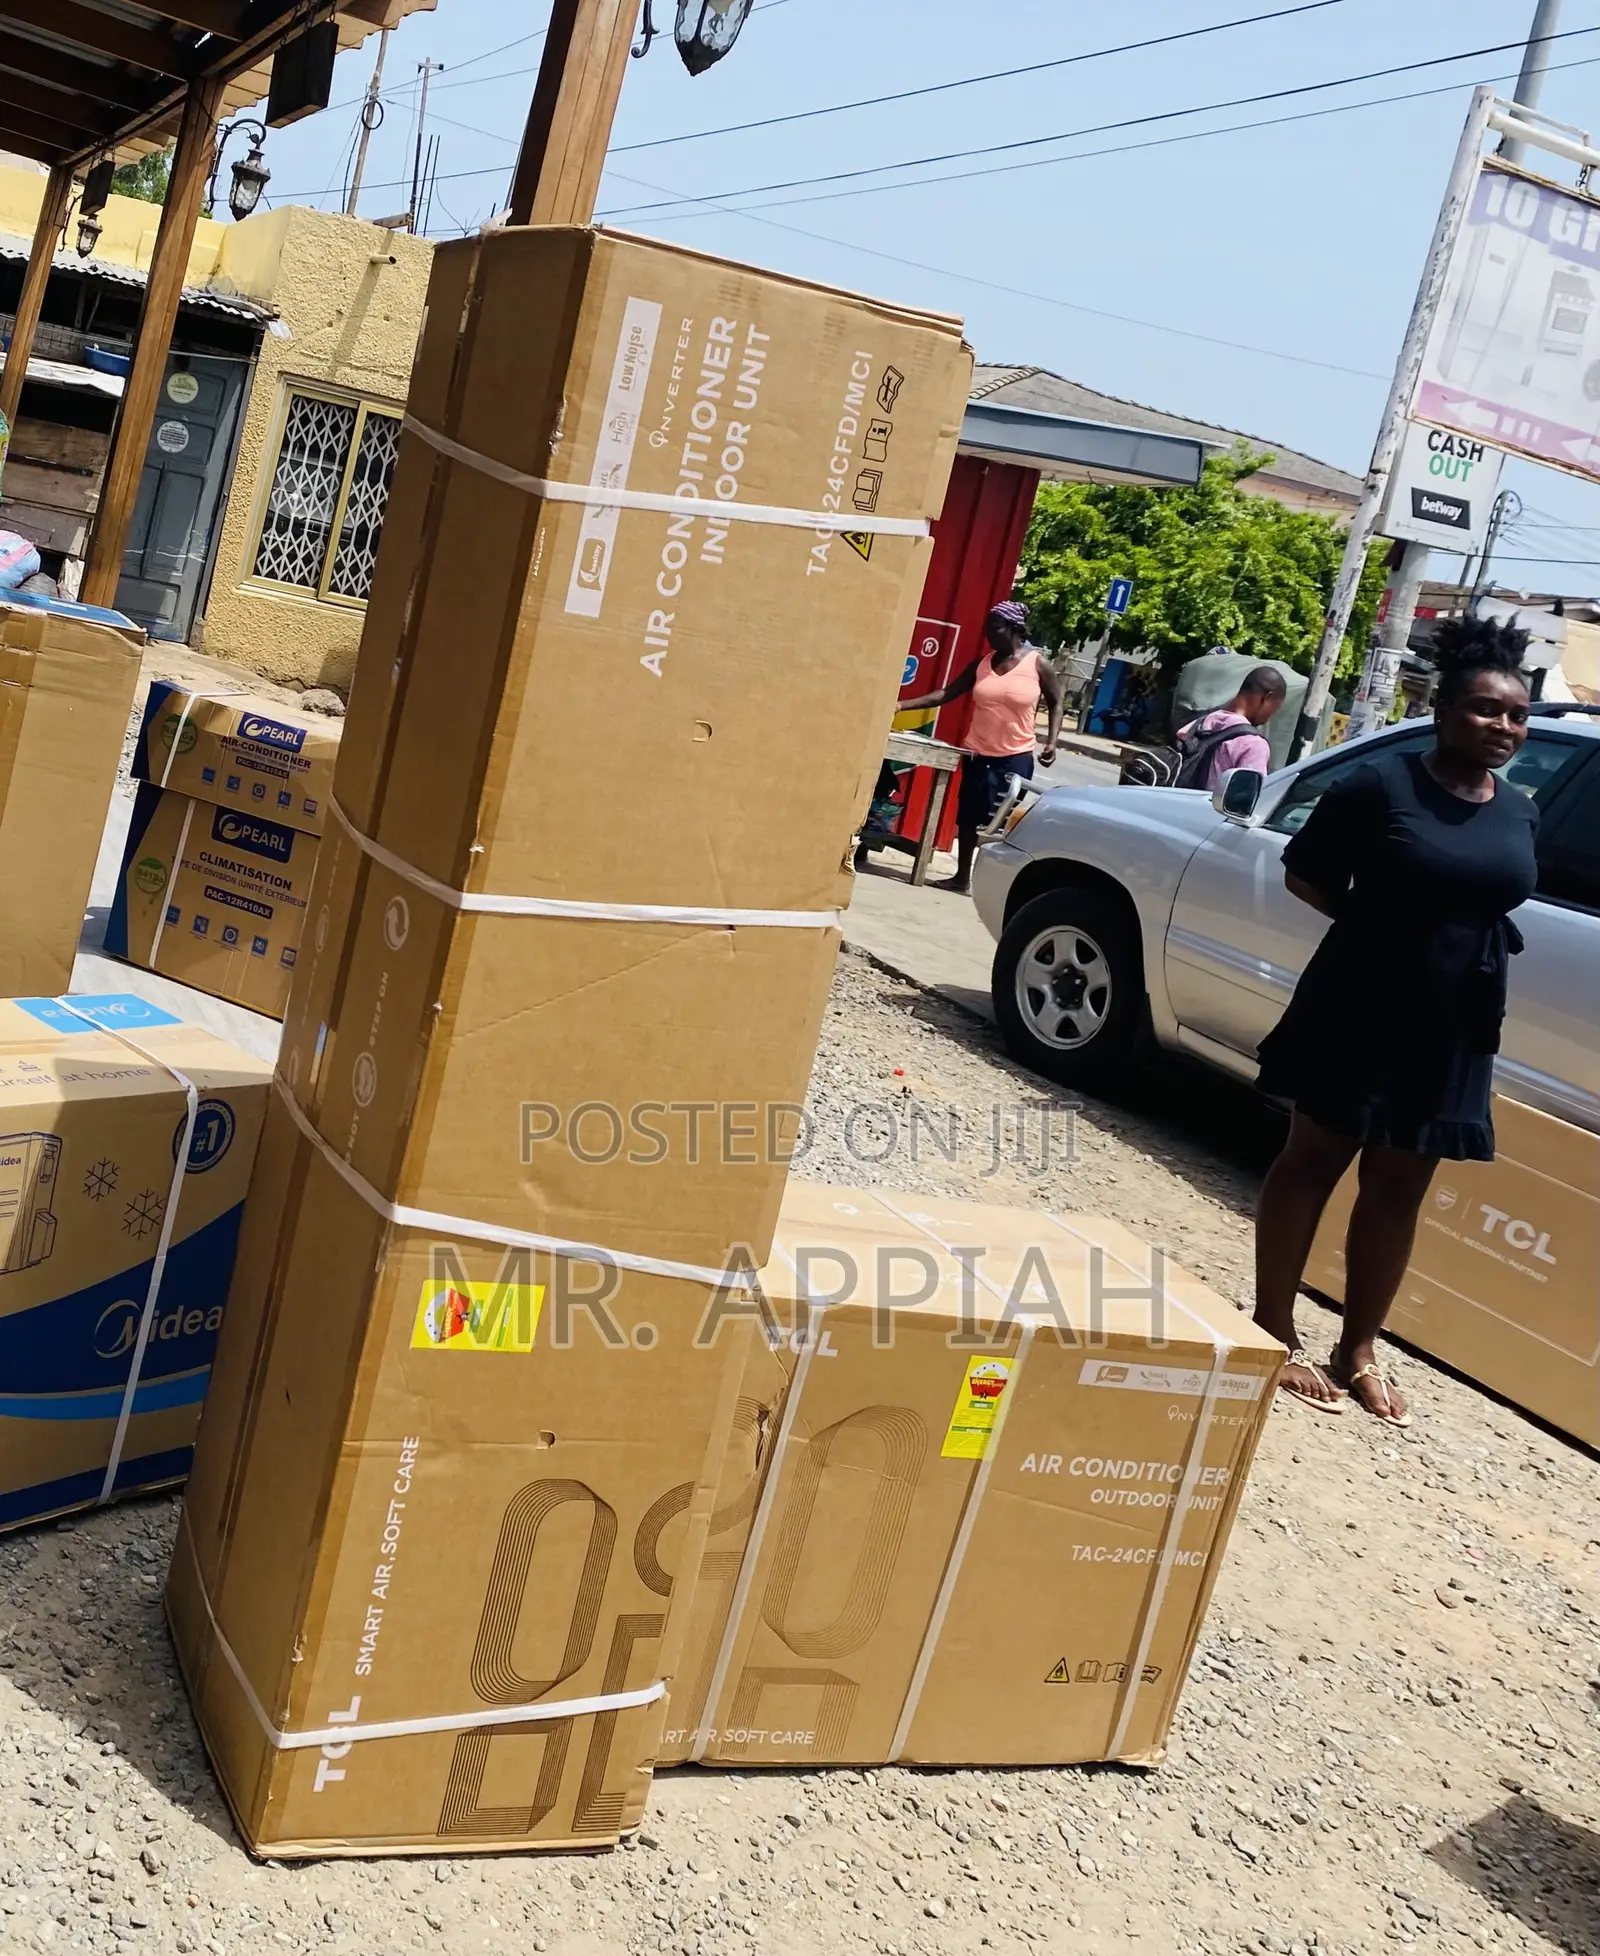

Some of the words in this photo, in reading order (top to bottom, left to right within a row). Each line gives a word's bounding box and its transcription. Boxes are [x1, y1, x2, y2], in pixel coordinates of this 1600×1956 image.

[1484, 174, 1540, 228] 10
[733, 323, 771, 410] UNIT
[656, 316, 737, 596] CONDITIONER
[1427, 429, 1485, 463] CASH
[1428, 453, 1474, 482] OUT
[1420, 496, 1464, 522] betway
[639, 609, 676, 678] AIR
[220, 735, 312, 769] AIR-CONDITIONER
[171, 855, 190, 869] TPE
[190, 861, 202, 873] DE
[203, 866, 238, 885] DIVISION
[199, 851, 293, 891] CLIMATISATION
[206, 889, 272, 917] PAC-12R410AX
[378, 971, 389, 998] ON
[61, 1072, 86, 1083] at
[85, 1068, 152, 1081] home
[195, 1119, 220, 1153] #1
[0, 1155, 22, 1167] idea
[1424, 1216, 1462, 1241] OFFICIAL
[1463, 1235, 1508, 1265] REGIONAL
[1507, 1259, 1549, 1284] PARTNER
[1480, 1203, 1558, 1266] TCL
[1019, 1452, 1063, 1475] AIR
[1090, 1488, 1177, 1510] OUTDOOR
[354, 1604, 385, 1677] SMART
[393, 1435, 420, 1494] CARE
[1071, 1544, 1209, 1569] TAC-24CFMCI
[312, 1695, 362, 1793] TCL
[770, 1730, 816, 1745] CARE
